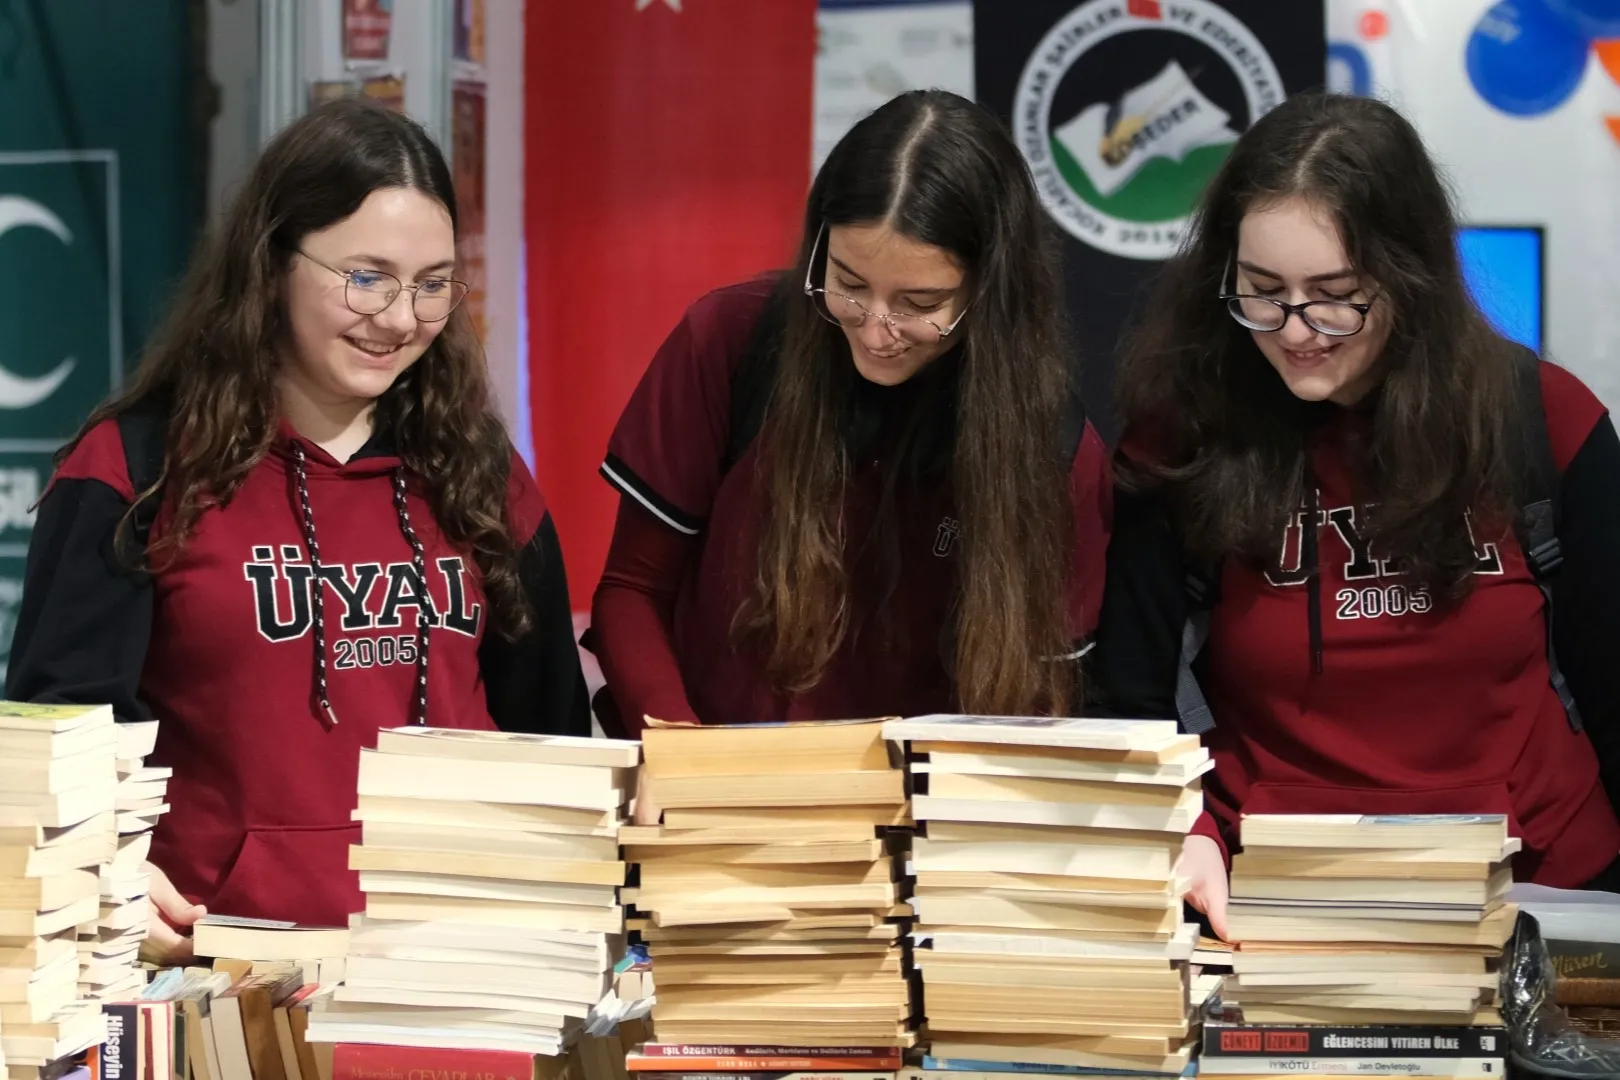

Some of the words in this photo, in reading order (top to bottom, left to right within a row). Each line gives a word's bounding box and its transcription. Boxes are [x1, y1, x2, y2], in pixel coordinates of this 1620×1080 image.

[244, 544, 481, 643] ÜYAL
[1336, 585, 1432, 619] 2005
[333, 635, 418, 670] 2005
[103, 1015, 124, 1079] Hüseyin
[663, 1046, 679, 1056] IŞIL
[682, 1046, 736, 1055] ÖZGENTÜRK
[1323, 1033, 1388, 1048] EĞLENCESİNİ
[1391, 1036, 1431, 1049] YİTİREN
[1434, 1035, 1460, 1049] ÜLKE
[1375, 1062, 1421, 1072] Devletoğlu
